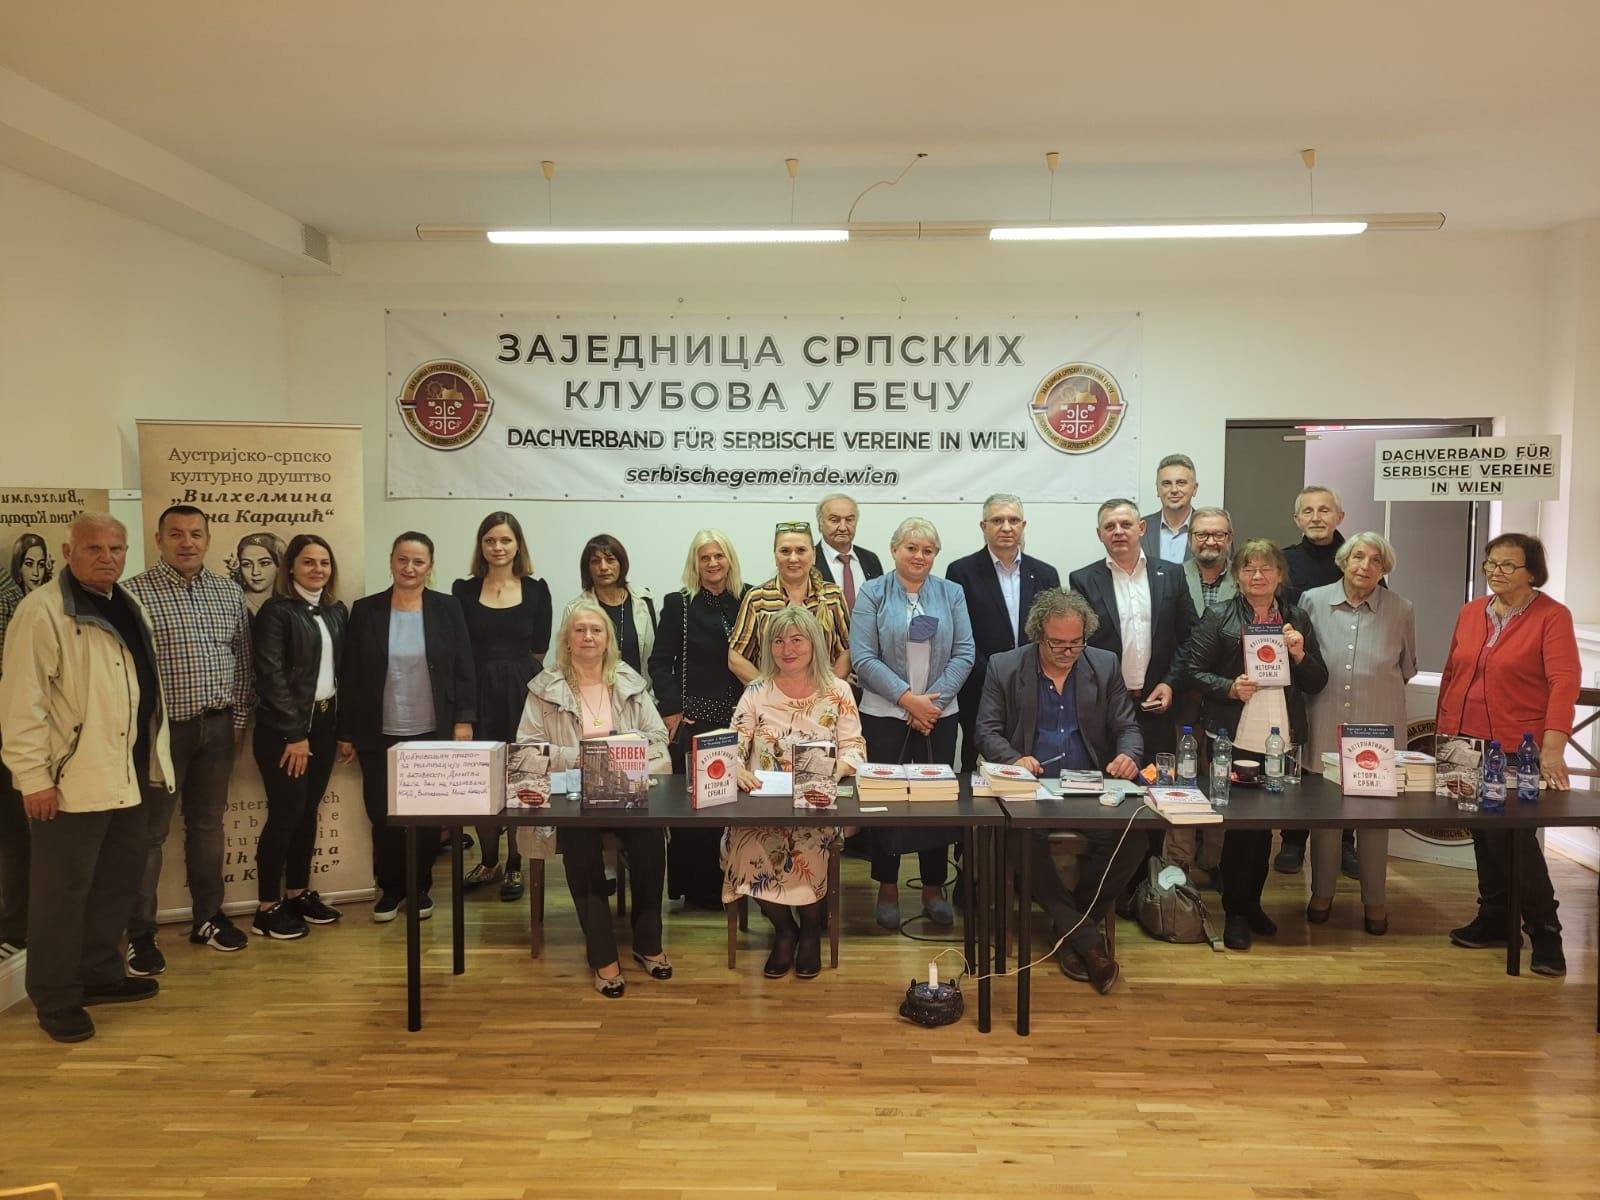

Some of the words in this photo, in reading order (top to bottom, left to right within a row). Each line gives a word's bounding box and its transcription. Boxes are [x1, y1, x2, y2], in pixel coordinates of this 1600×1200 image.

[498, 333, 782, 369] ЗАЈЕДНИЦА
[803, 335, 1022, 364] СРПСКИХ
[565, 381, 785, 410] КЛУБОВА
[805, 382, 831, 410] У
[853, 382, 971, 410] БЕЧУ
[507, 428, 665, 448] DACHVERBAND
[673, 427, 714, 449] FÜR
[723, 431, 834, 449] SERBISCHE
[844, 431, 930, 449] VEREINE
[940, 431, 960, 449] IN
[970, 431, 1026, 449] WIEN
[168, 447, 332, 465] Аустријско-српско
[1382, 447, 1506, 461] DACHVERBAND
[1516, 443, 1550, 458] FÜR
[170, 471, 253, 485] културно
[257, 471, 331, 485] друштво
[627, 465, 898, 487] serbischegemeinde.wien
[1383, 464, 1470, 477] SERBISCHE
[1480, 463, 1553, 476] VEREINE
[1431, 481, 1447, 493] IN
[1458, 481, 1502, 493] WIEN
[205, 511, 229, 523] на
[609, 746, 646, 760] SERBEN
